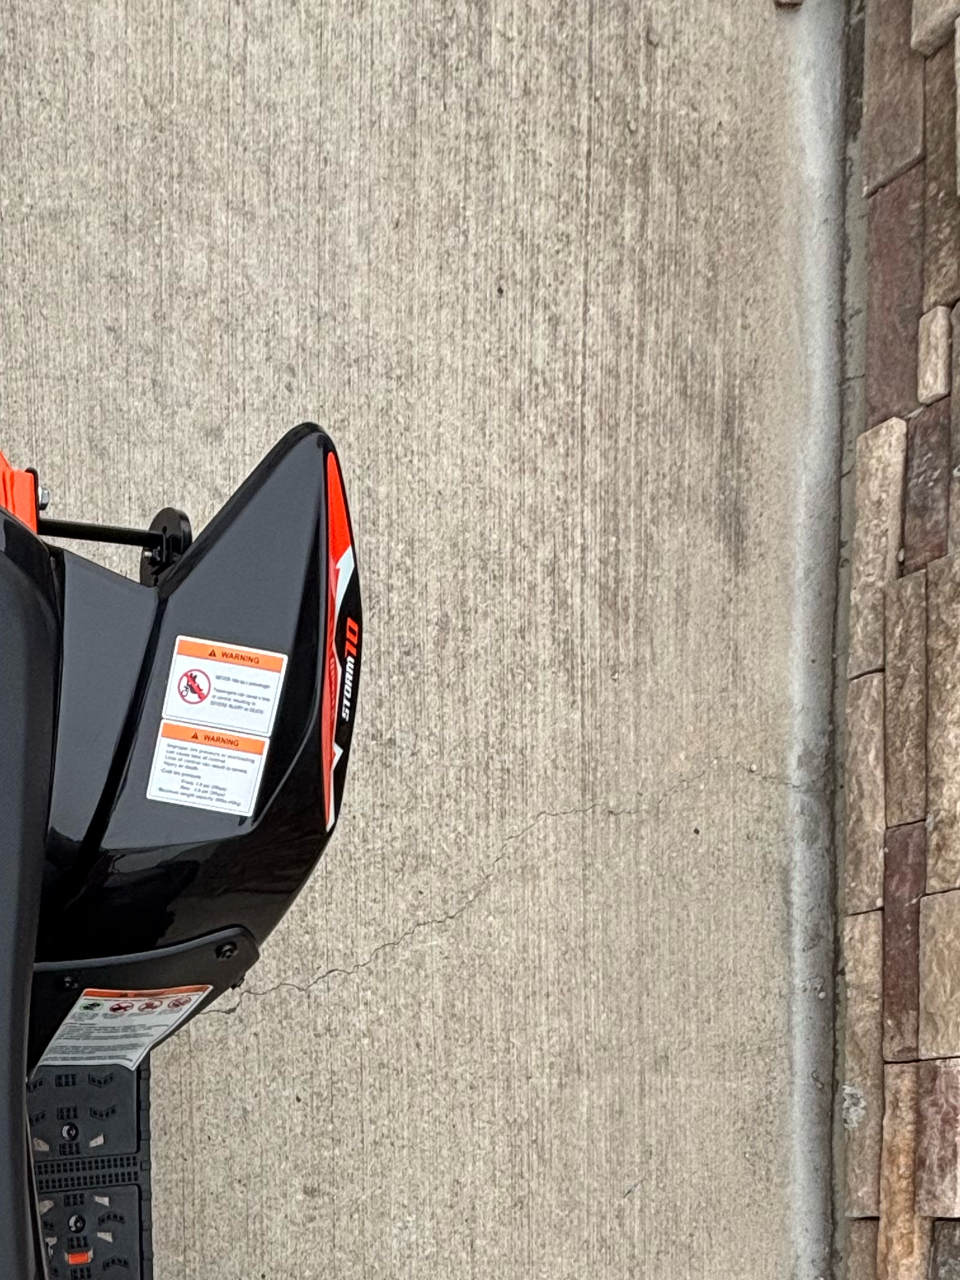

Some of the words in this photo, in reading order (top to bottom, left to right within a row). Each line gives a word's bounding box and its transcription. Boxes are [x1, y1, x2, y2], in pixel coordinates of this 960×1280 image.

[221, 651, 259, 664] WARNING
[342, 617, 359, 722] STORM70
[203, 734, 239, 747] WARNING
